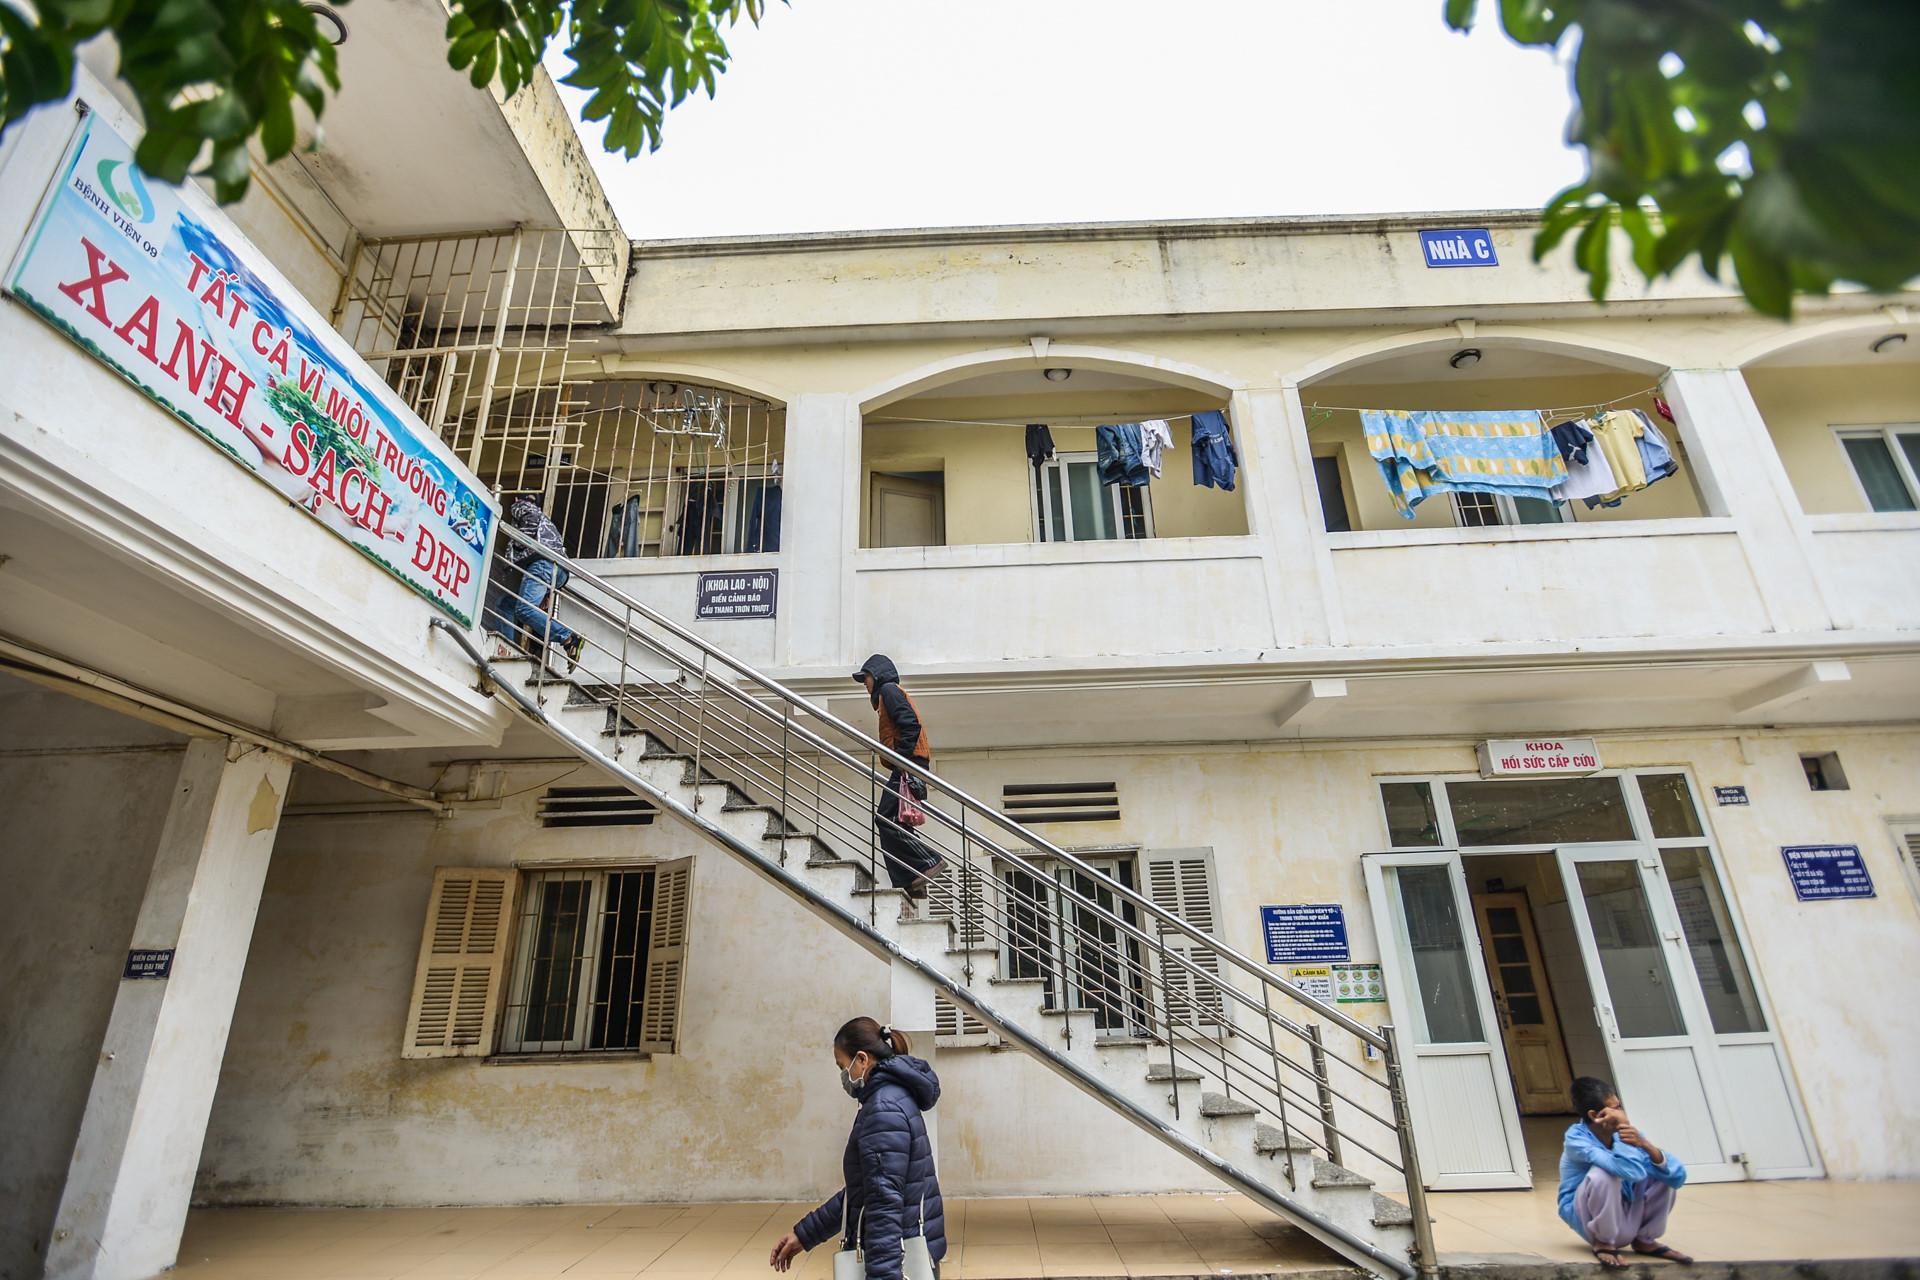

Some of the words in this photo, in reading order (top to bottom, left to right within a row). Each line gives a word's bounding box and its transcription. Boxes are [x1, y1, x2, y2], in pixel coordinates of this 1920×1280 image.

[74, 177, 111, 214] BỆNH
[112, 212, 142, 243] VIỆN
[143, 240, 158, 258] 09
[1428, 235, 1472, 260] NHÀ
[1474, 239, 1490, 259] C
[187, 252, 249, 330] TẤT
[252, 320, 292, 376] CẢ
[299, 358, 326, 403] VÌ
[325, 387, 370, 446] MÔI
[373, 430, 447, 516] TRƯỜNG
[58, 236, 256, 430] XANH
[283, 421, 393, 540] SẠCH
[411, 524, 470, 598] ĐẸP
[705, 578, 729, 592] (KHOA
[731, 578, 745, 590] LAO
[752, 575, 769, 592] NỘI)
[728, 592, 746, 603] CẢNH
[747, 593, 761, 602] BÁO
[714, 605, 733, 614] THANG
[734, 604, 750, 613] TRƠN
[1525, 742, 1564, 751] KHOA
[1524, 754, 1545, 768] SỨC
[1548, 753, 1570, 768] CẤP
[1572, 753, 1596, 767] CỨU
